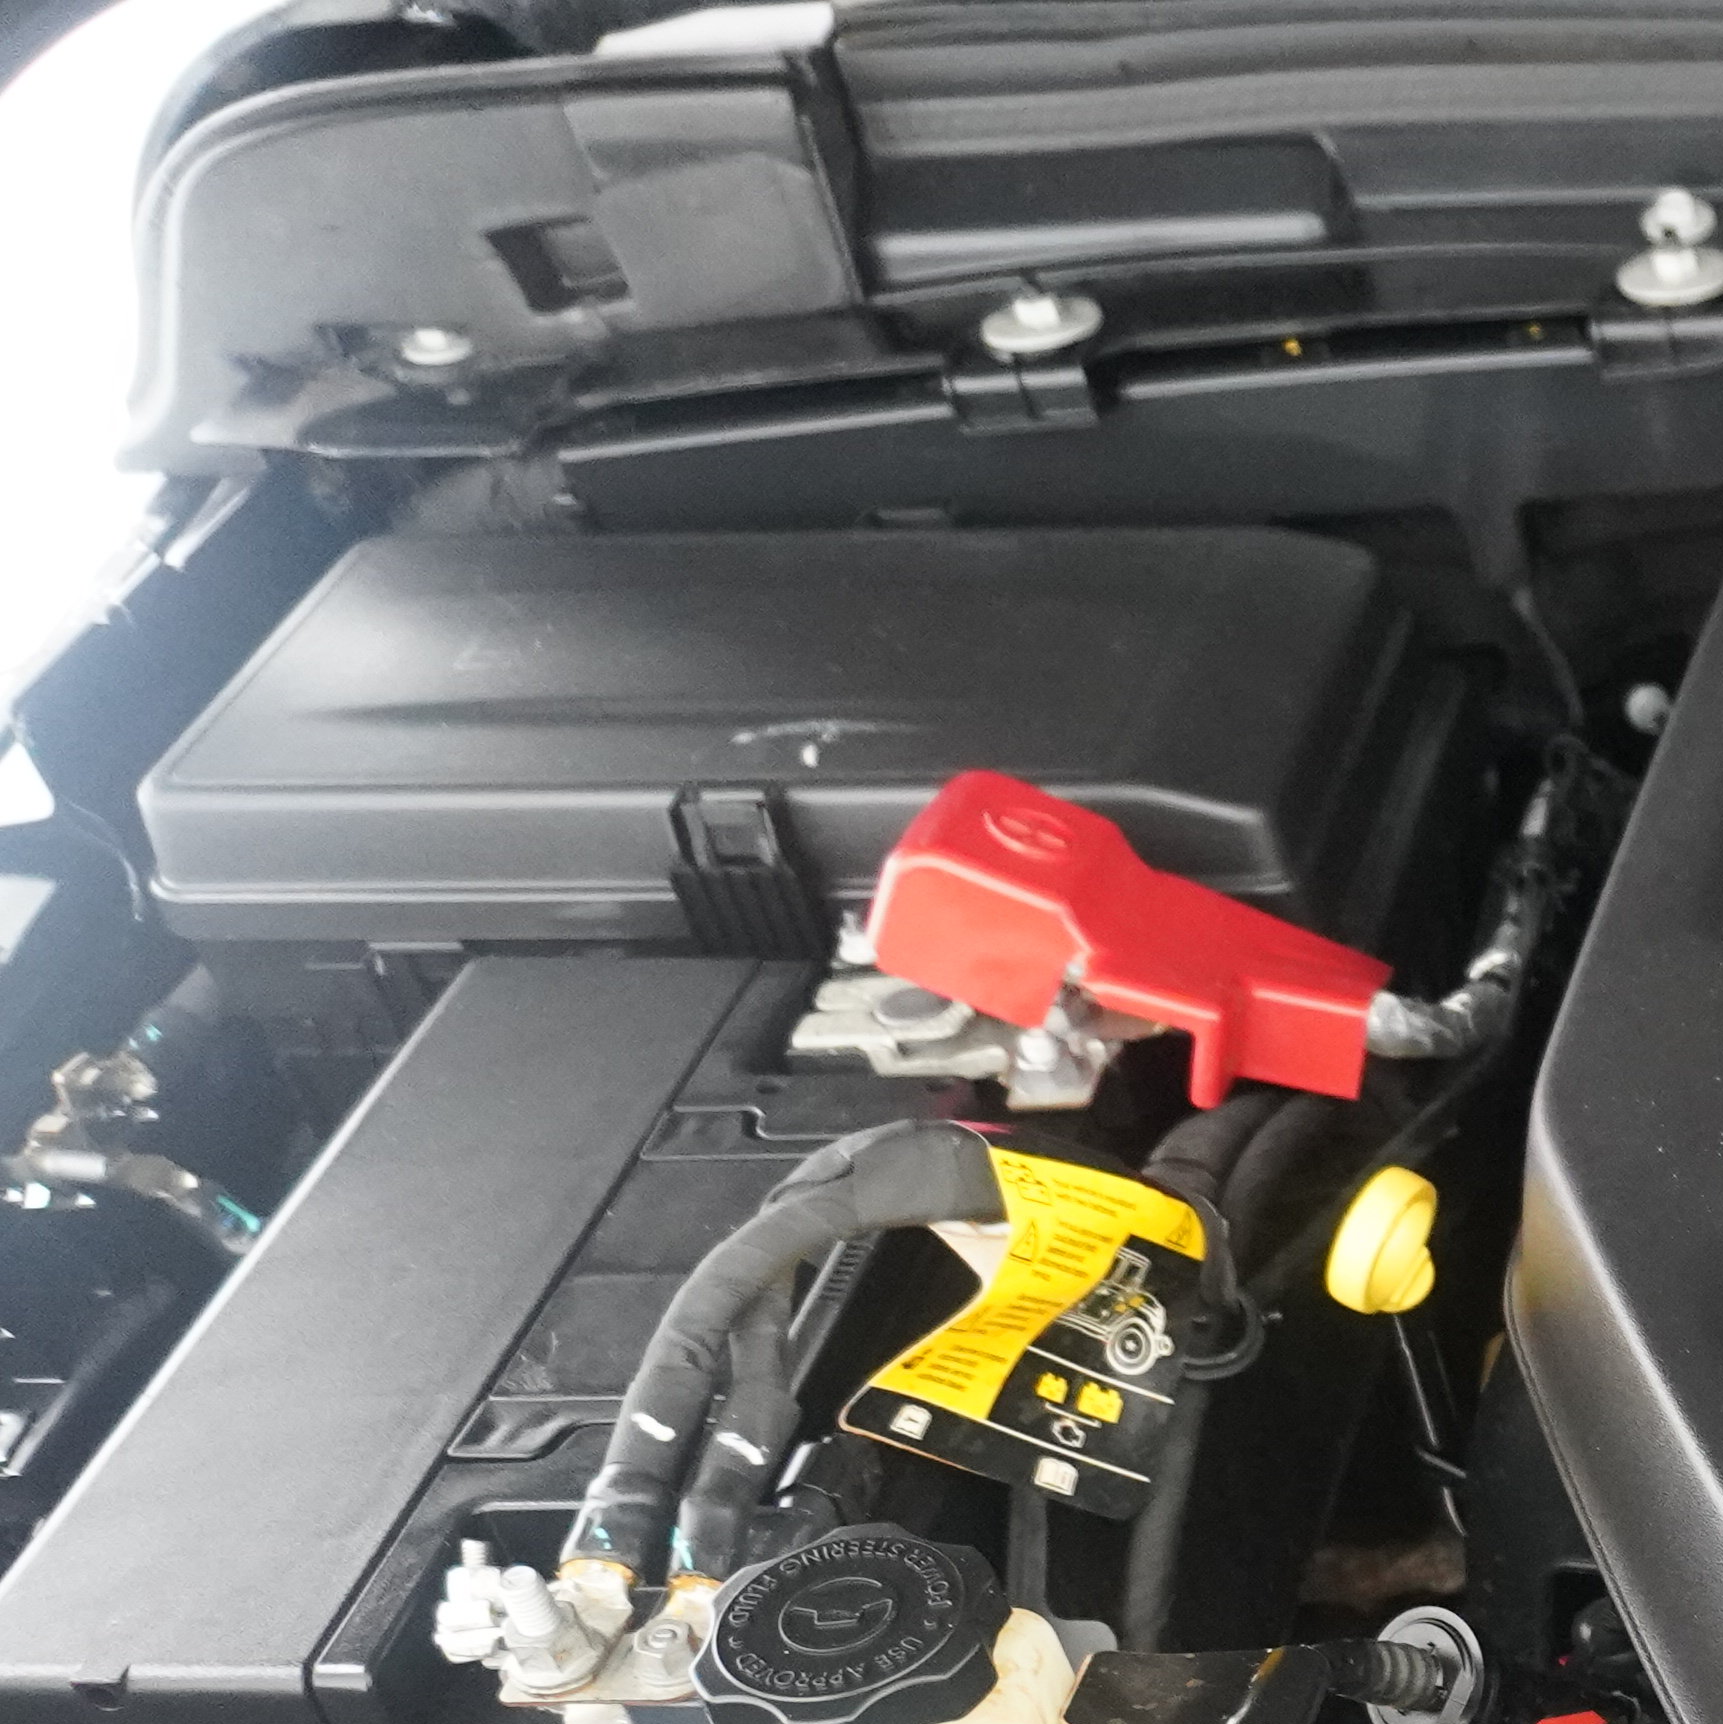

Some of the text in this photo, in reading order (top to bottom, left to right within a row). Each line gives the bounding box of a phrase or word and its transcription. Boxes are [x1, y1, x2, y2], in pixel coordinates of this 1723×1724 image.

[728, 1540, 953, 1628] POWER STEERING FLUID
[736, 1636, 924, 1690] USE APPROVED
